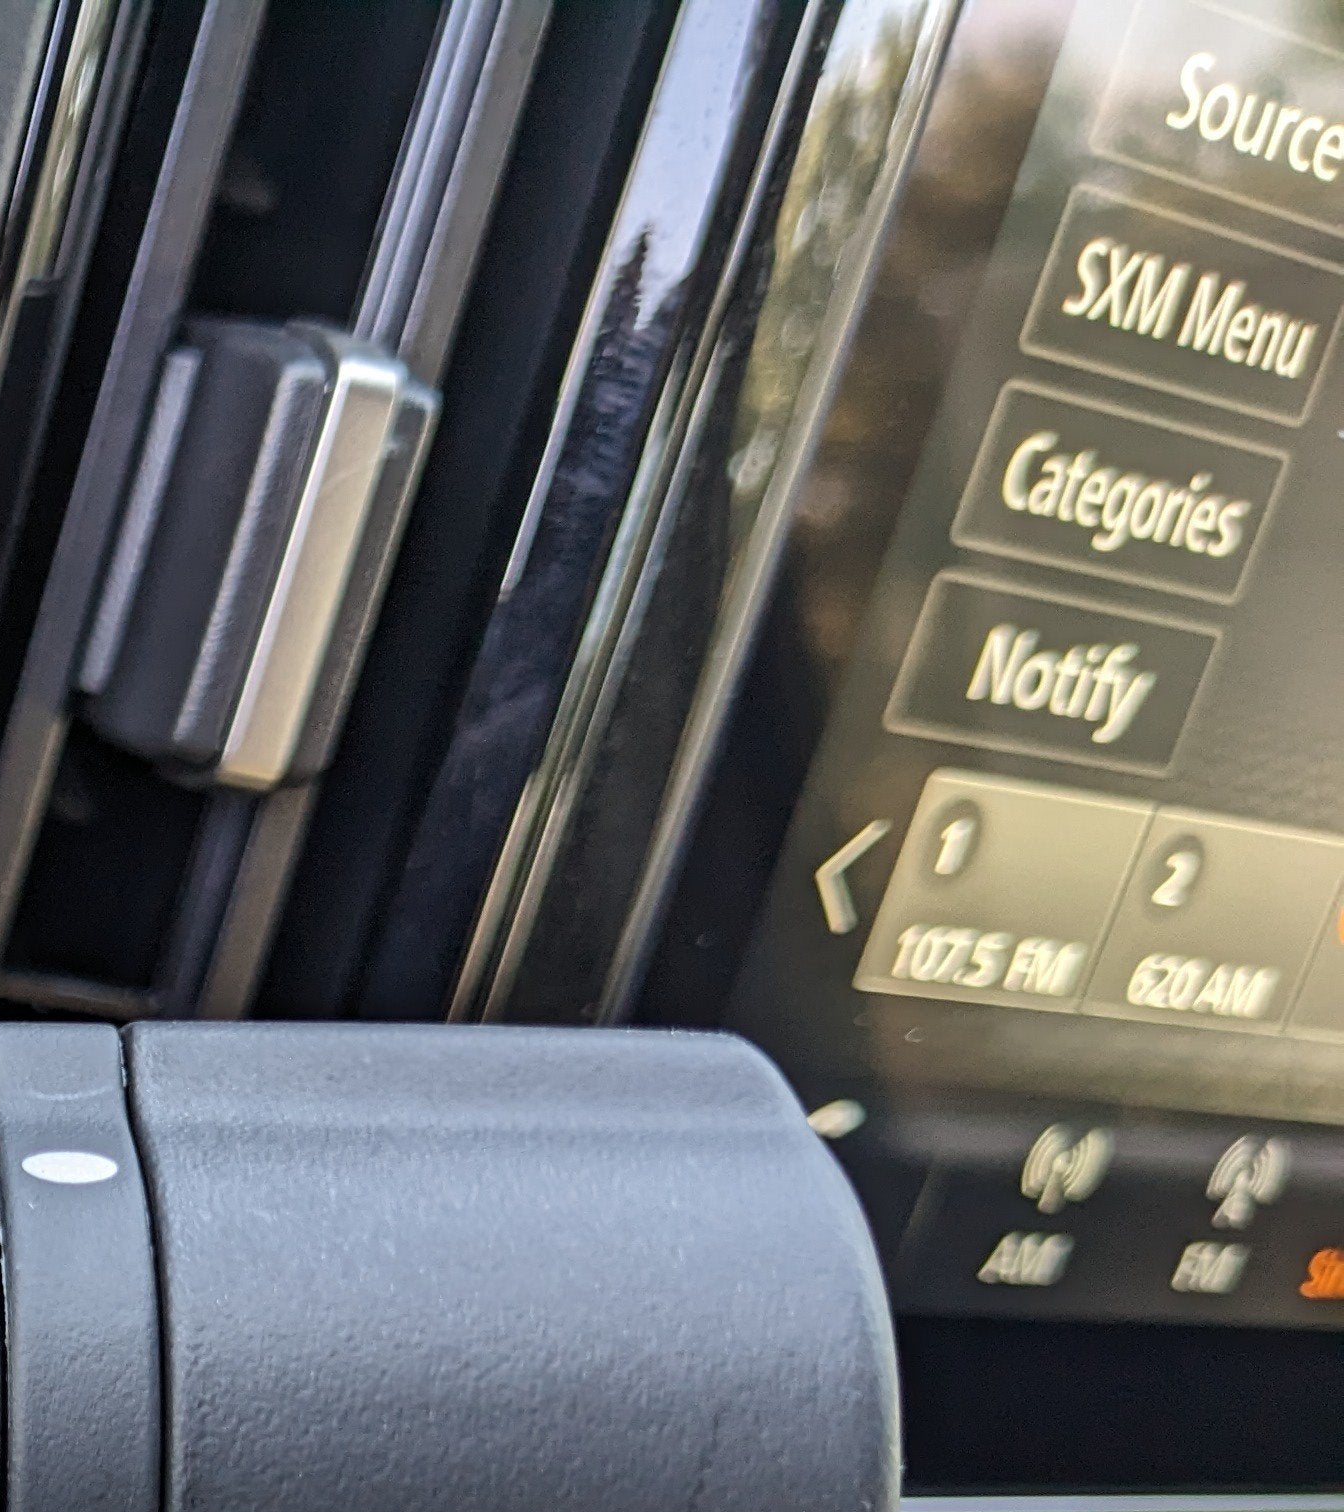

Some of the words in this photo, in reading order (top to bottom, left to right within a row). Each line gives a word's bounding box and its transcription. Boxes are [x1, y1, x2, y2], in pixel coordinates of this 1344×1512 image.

[1167, 52, 1344, 182] Source
[1063, 238, 1182, 339] SXM
[1180, 273, 1318, 378] Menu
[1002, 432, 1252, 557] Categories
[966, 624, 1158, 744] Notify
[934, 818, 974, 875] 1
[1152, 850, 1202, 907] 2
[1002, 936, 1090, 997] FM
[1127, 953, 1210, 1010] 620
[1192, 963, 1280, 1020] AM
